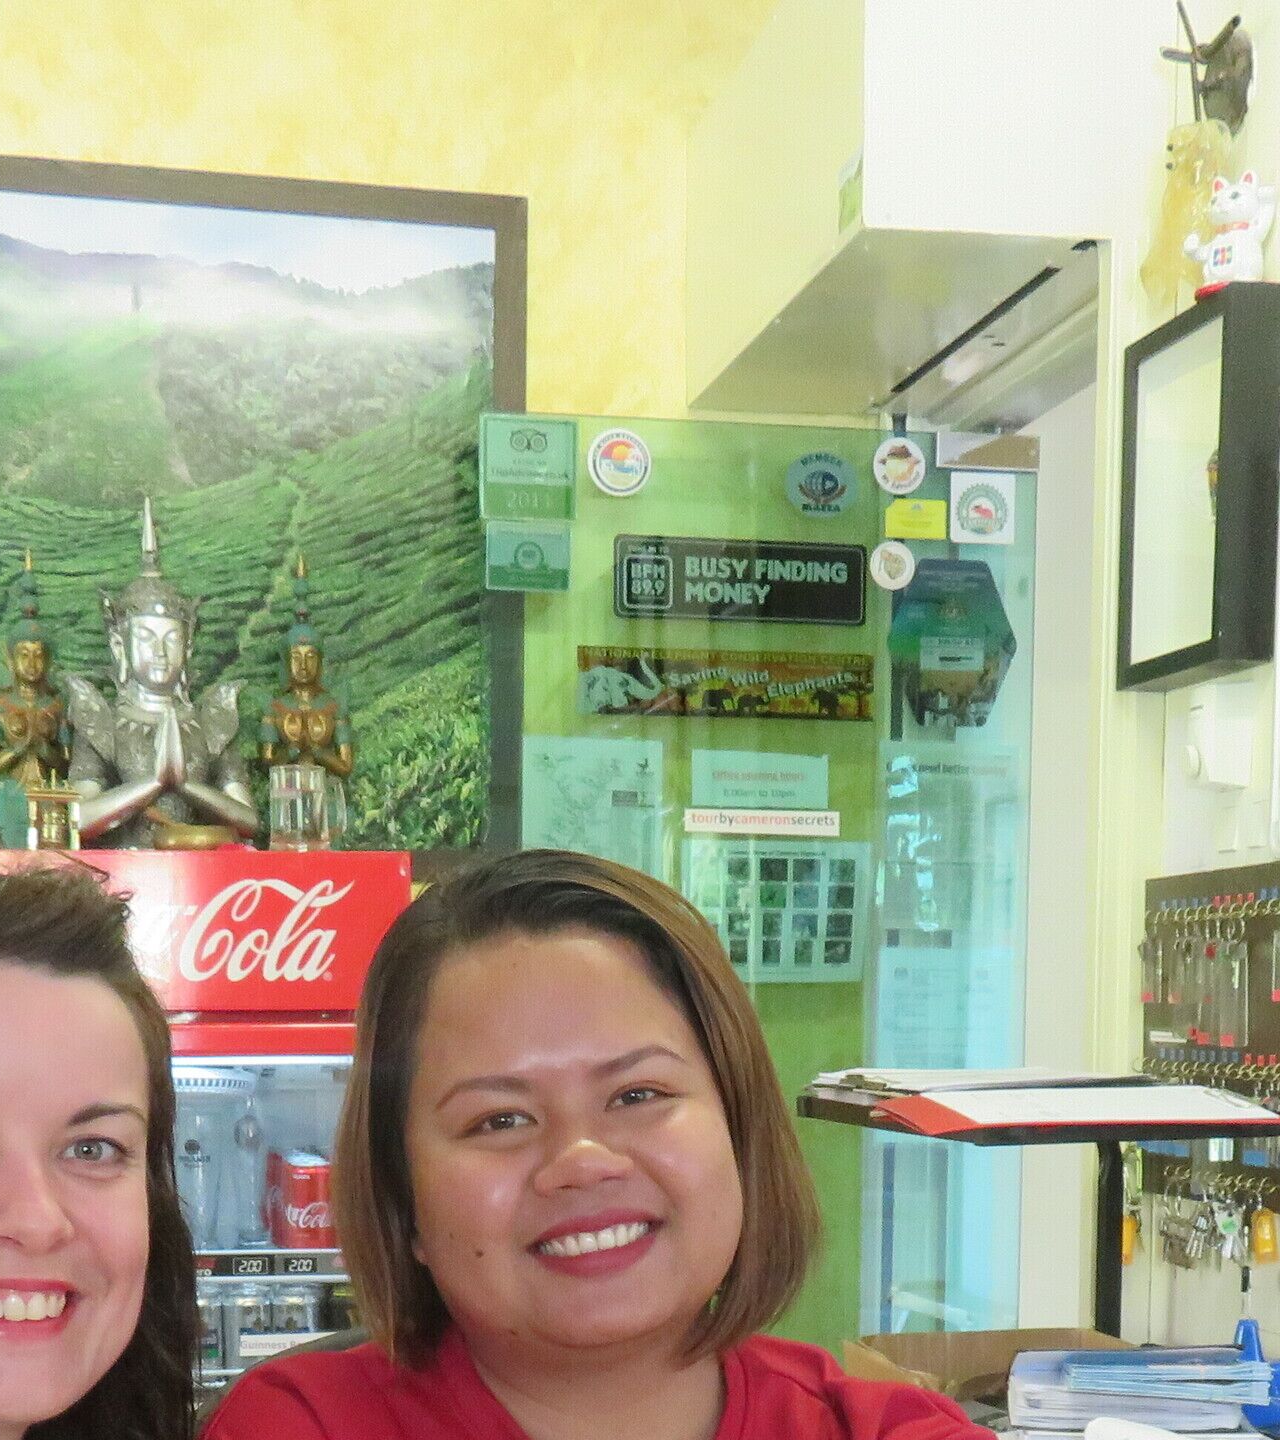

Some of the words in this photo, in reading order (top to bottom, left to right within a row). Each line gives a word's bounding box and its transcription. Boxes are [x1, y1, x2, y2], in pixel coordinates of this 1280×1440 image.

[630, 562, 666, 580] BFM
[685, 555, 749, 580] BUSY
[755, 559, 849, 584] FINDING
[630, 579, 666, 596] 89.9
[685, 581, 771, 605] MONEY
[669, 667, 726, 688] Saving
[730, 669, 769, 688] Wild
[767, 671, 854, 699] Elephants
[692, 812, 835, 827] tourbycameronsecrets
[238, 1260, 262, 1273] 2.00
[289, 1260, 313, 1273] 2.00
[240, 1340, 288, 1351] Guinness
